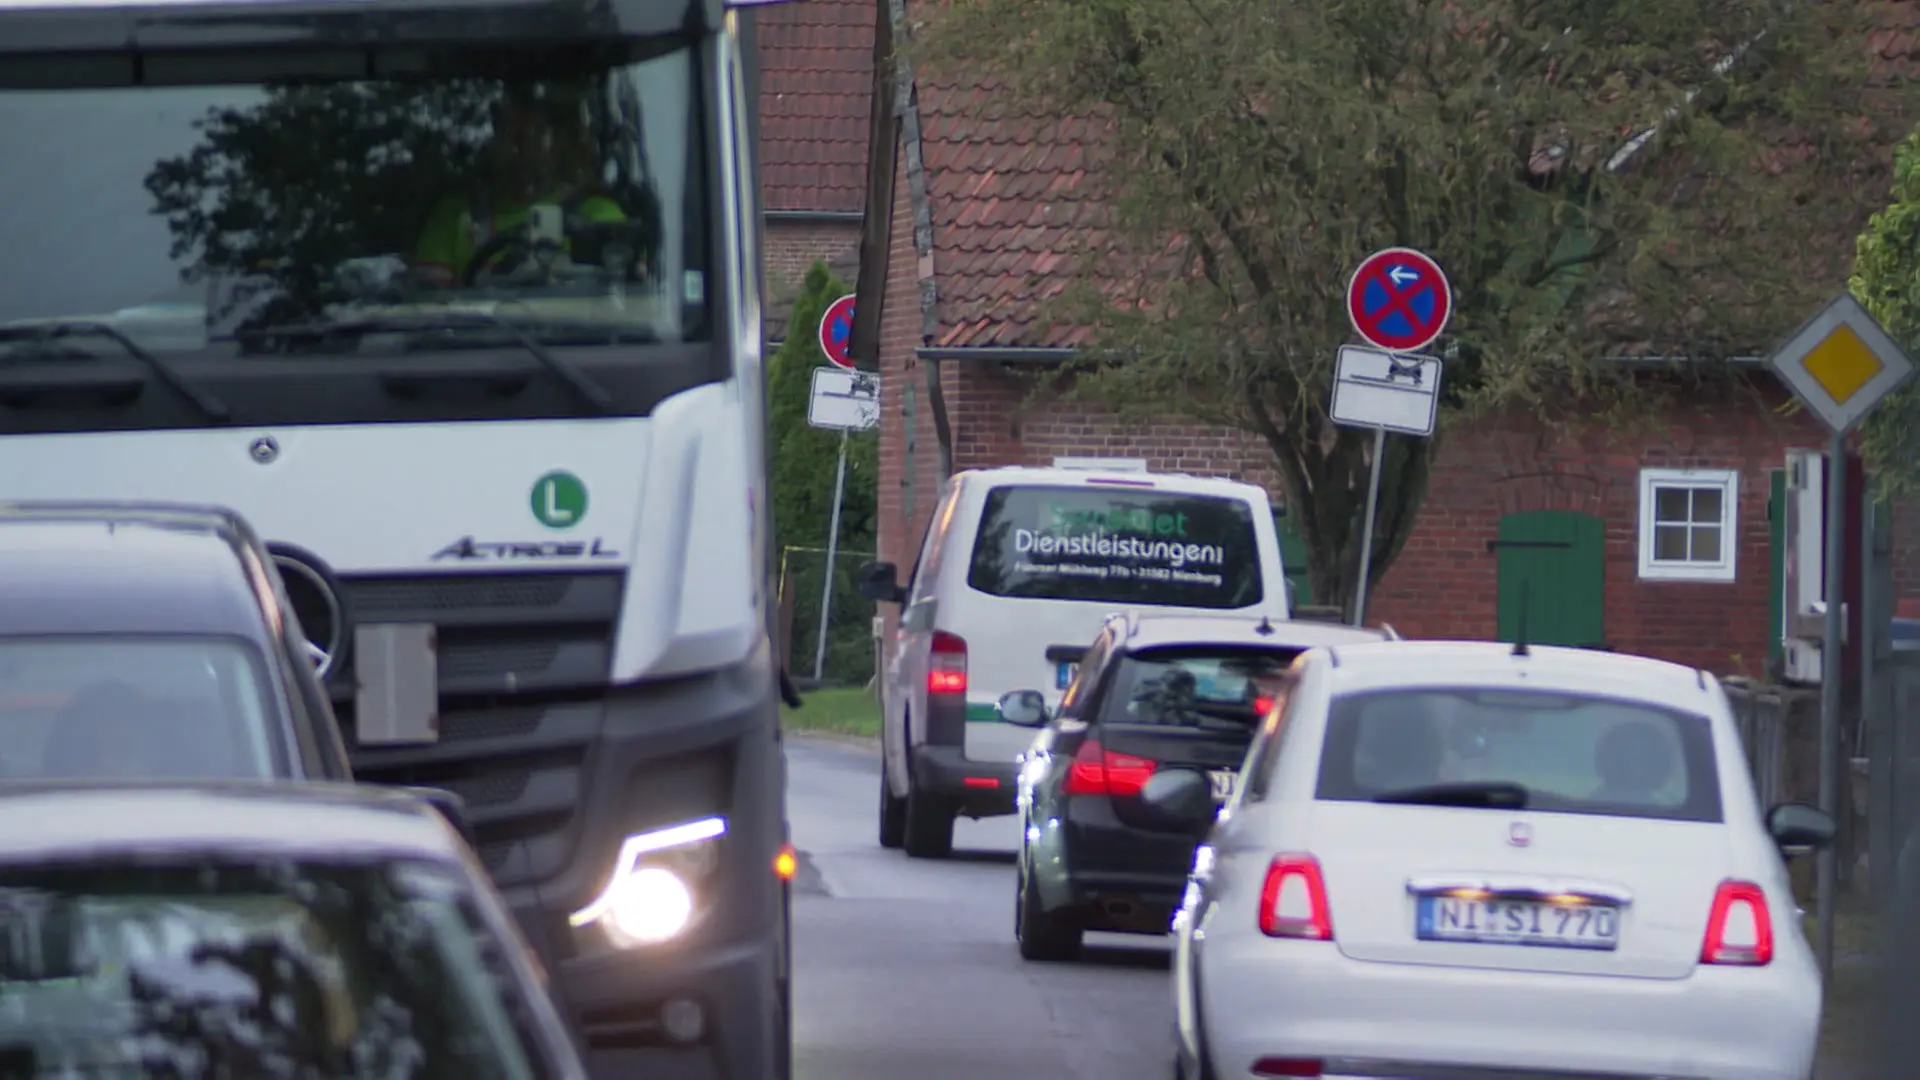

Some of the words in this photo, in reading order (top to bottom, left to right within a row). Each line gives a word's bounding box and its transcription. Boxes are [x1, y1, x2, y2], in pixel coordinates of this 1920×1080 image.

[544, 478, 574, 521] L
[590, 536, 620, 558] L
[1439, 898, 1478, 930] NI
[1505, 904, 1543, 934] SI
[1553, 907, 1616, 938] 770
